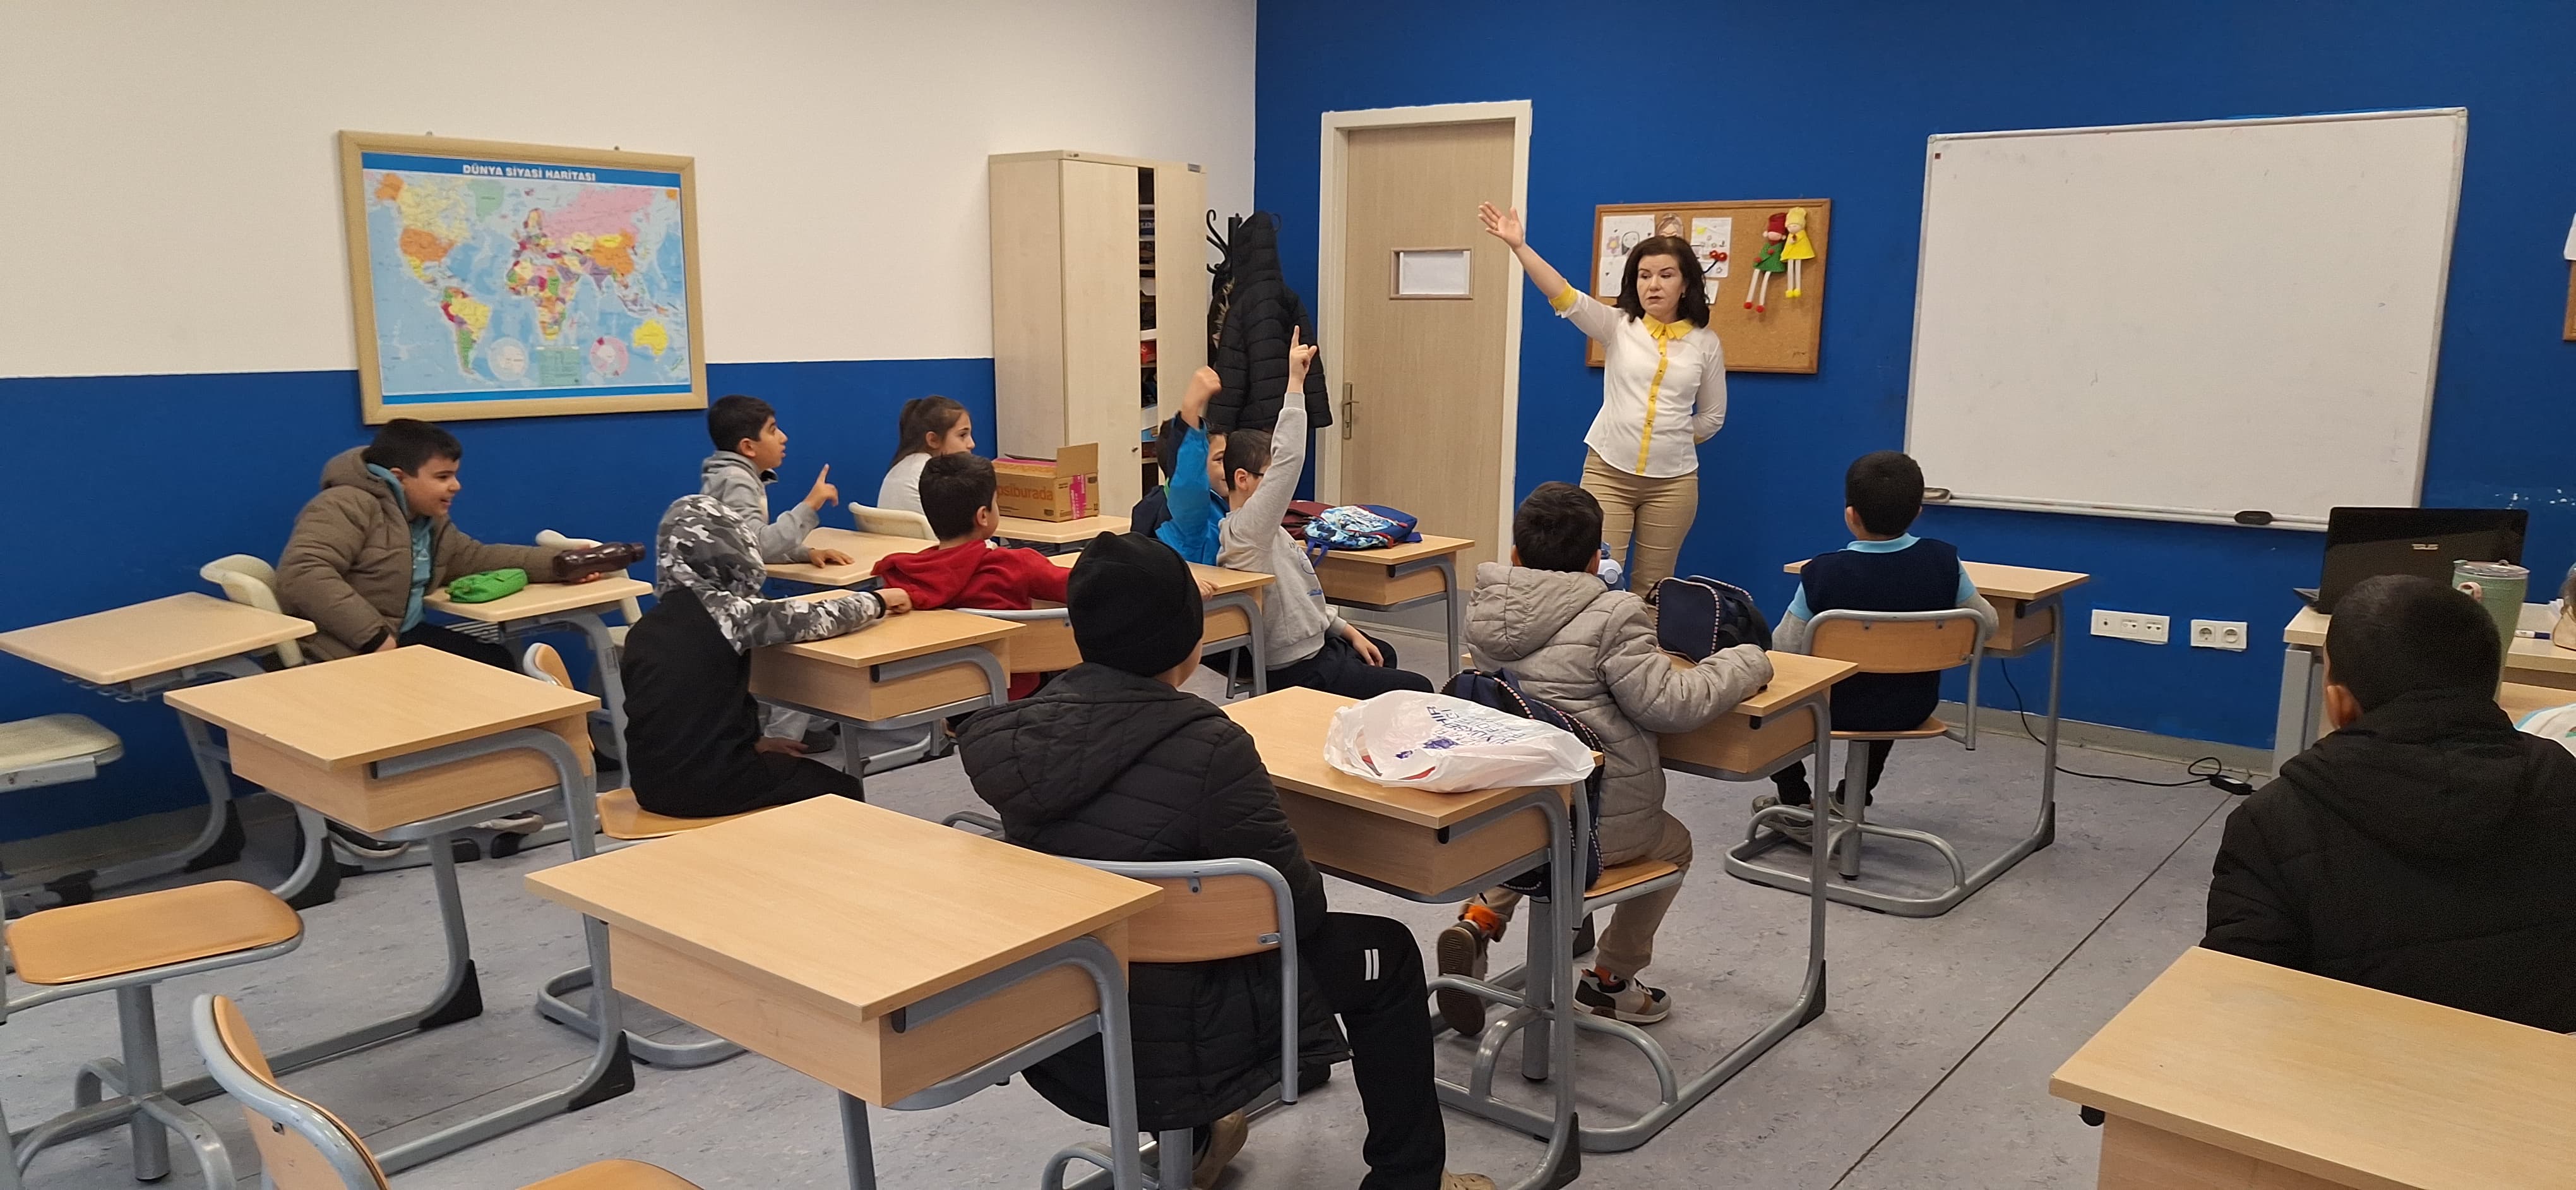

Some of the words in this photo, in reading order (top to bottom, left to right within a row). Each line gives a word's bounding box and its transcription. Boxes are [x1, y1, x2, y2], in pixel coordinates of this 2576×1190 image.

[463, 163, 504, 176] DÜNYA
[506, 165, 542, 179] SİYASİ
[545, 169, 596, 182] HARİTASI
[997, 485, 1054, 501] psiburada
